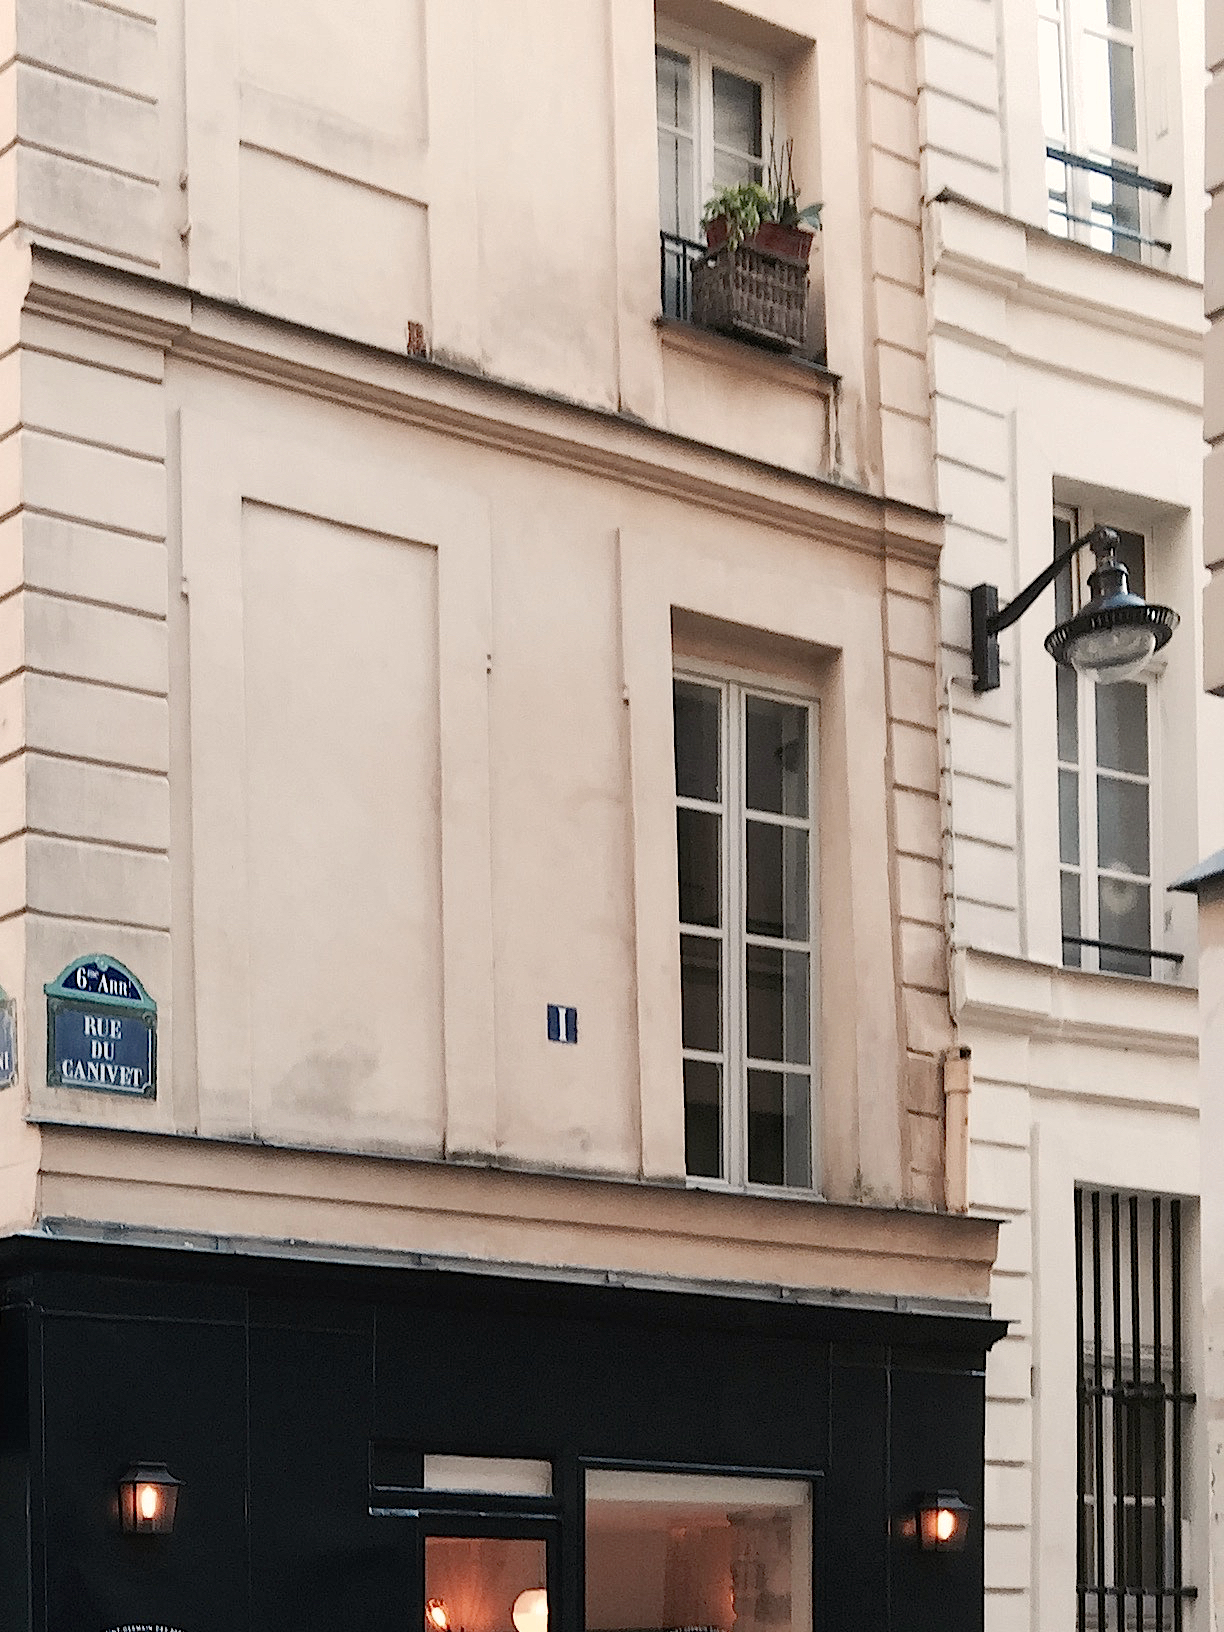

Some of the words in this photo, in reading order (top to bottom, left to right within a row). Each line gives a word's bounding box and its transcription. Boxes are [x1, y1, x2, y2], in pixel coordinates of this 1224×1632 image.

[84, 1015, 122, 1040] RUE
[91, 1040, 115, 1061] DU
[62, 1059, 143, 1088] CANIVET
